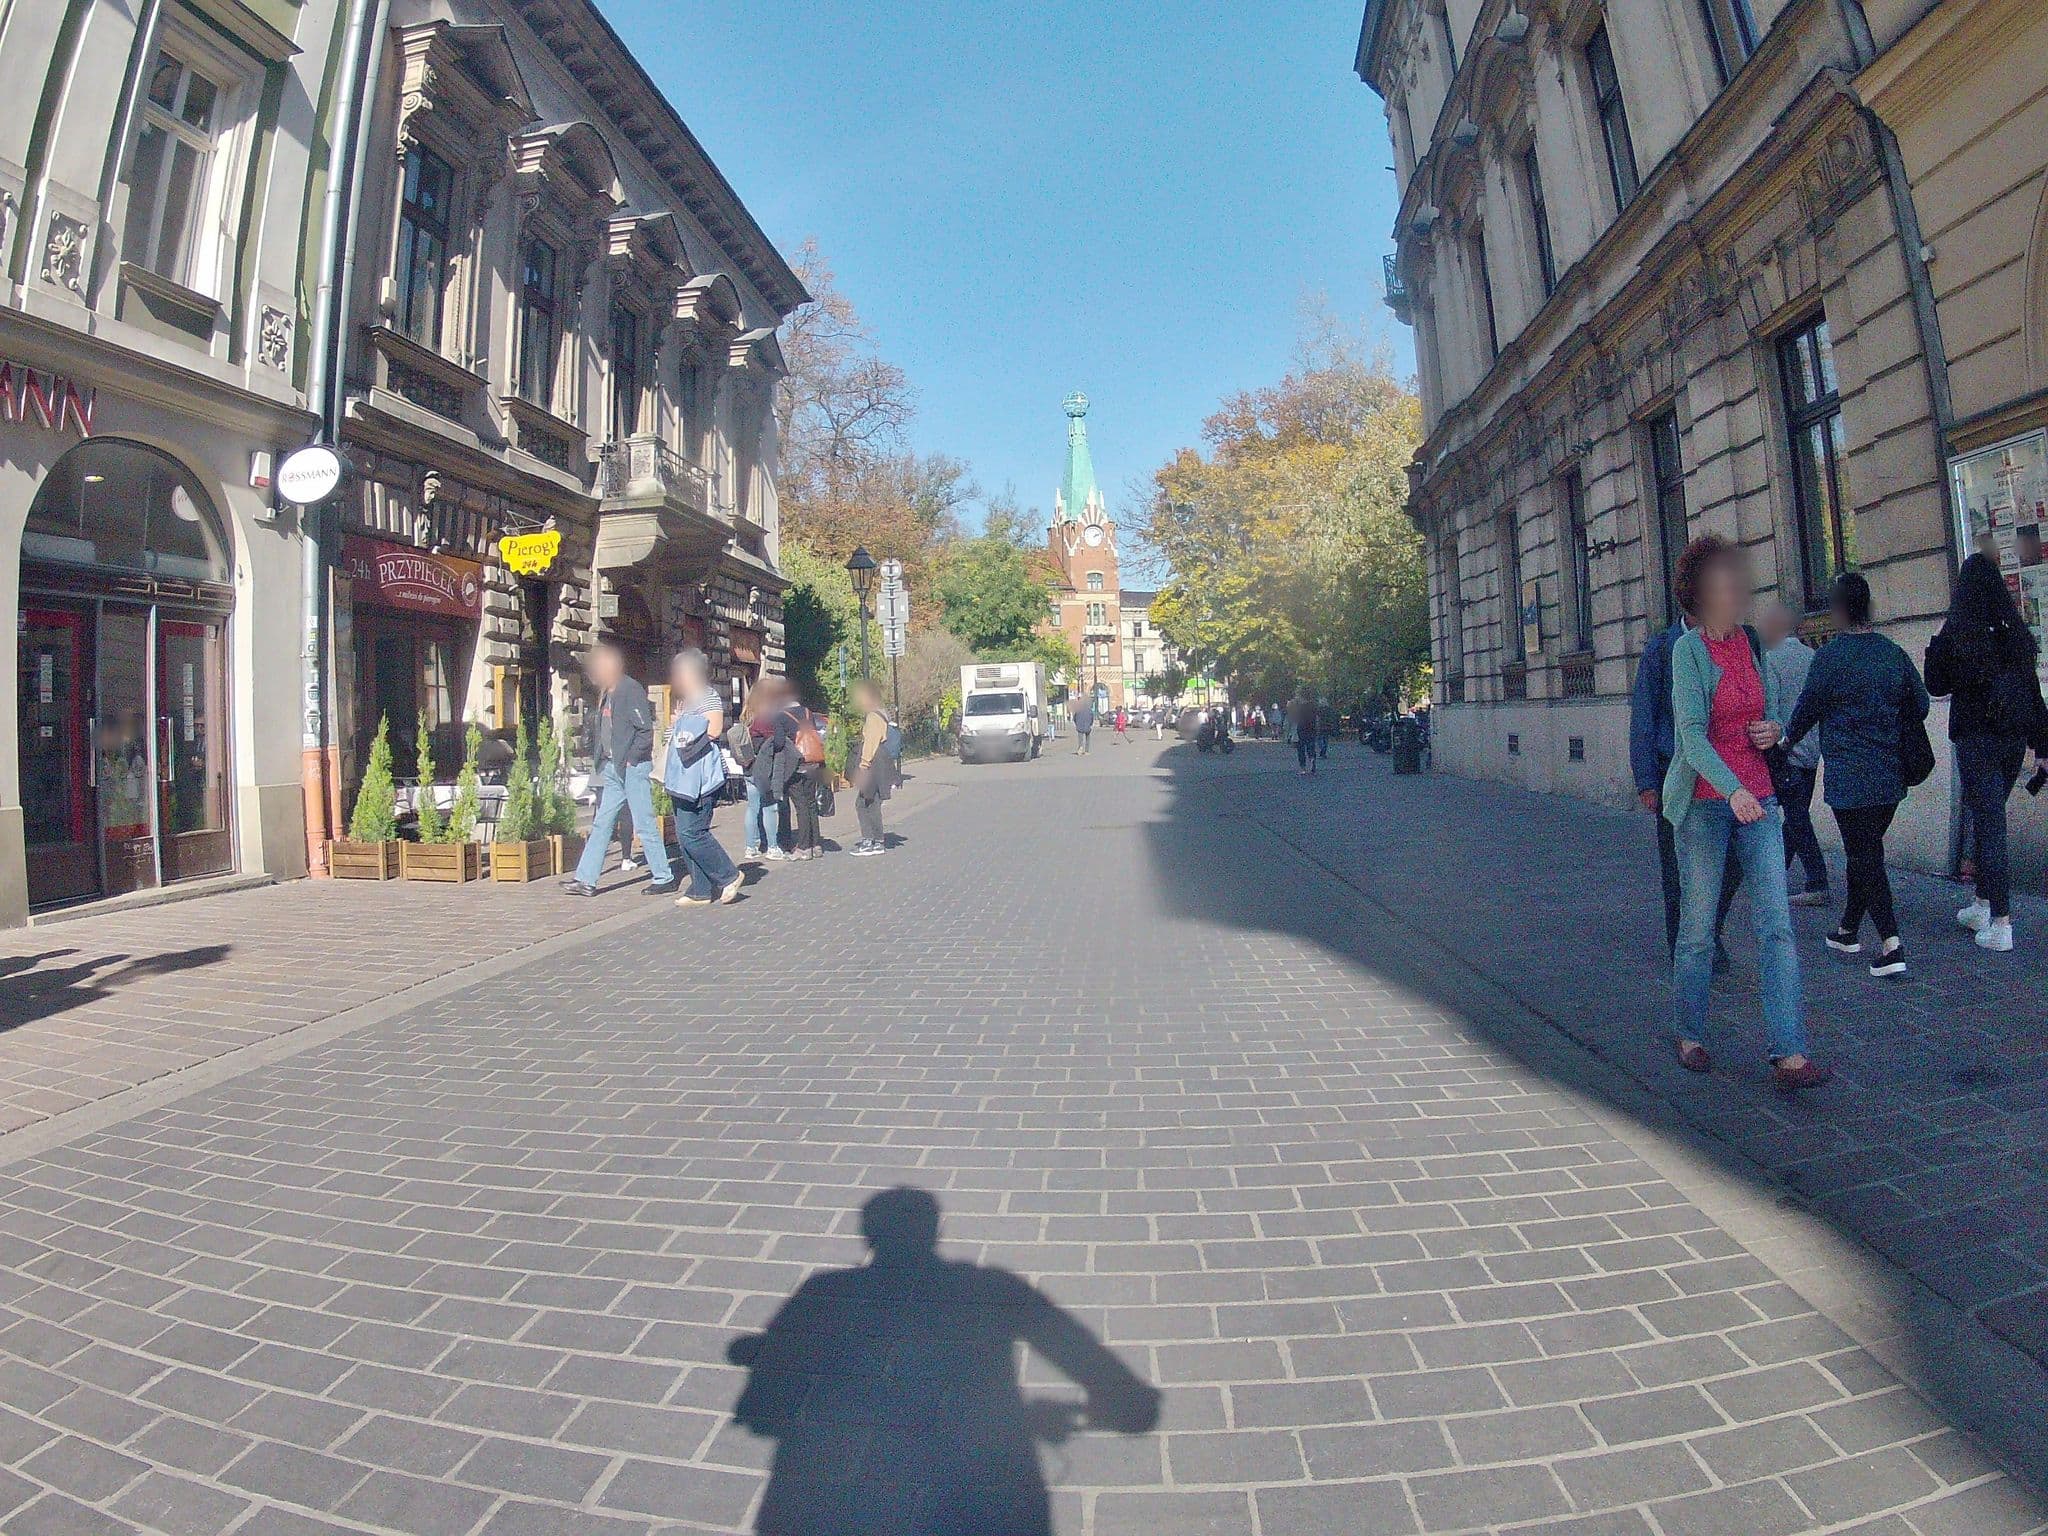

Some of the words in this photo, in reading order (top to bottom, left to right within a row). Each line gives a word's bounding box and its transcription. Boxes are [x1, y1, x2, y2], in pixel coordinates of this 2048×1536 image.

[282, 467, 337, 483] ROSSMANN
[507, 540, 554, 556] Pierogi
[351, 558, 371, 580] 24h
[521, 559, 538, 569] 24h
[379, 559, 456, 597] PRZYPIECEK
